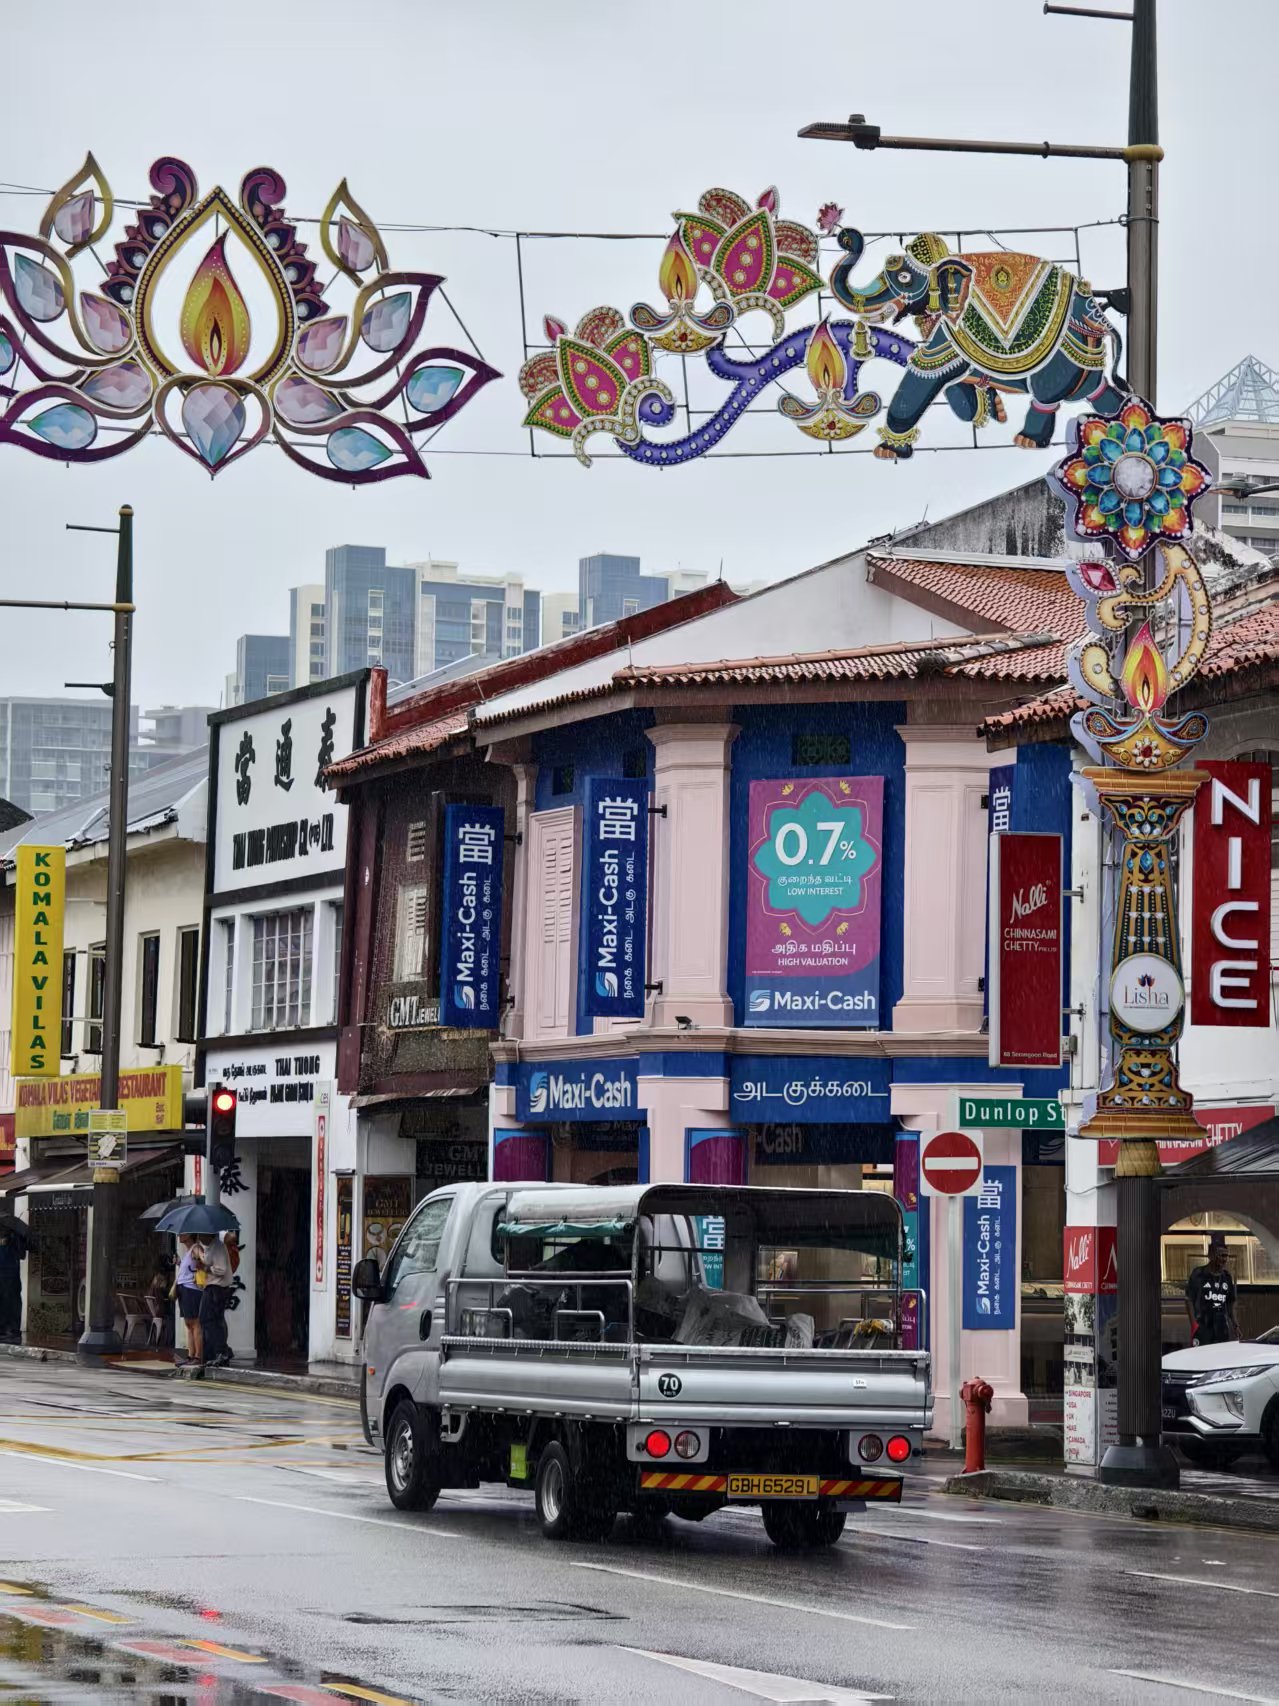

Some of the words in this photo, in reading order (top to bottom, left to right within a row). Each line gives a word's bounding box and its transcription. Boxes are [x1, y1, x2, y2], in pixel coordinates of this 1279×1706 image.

[598, 796, 639, 841] 當
[458, 823, 496, 866] 當
[775, 821, 857, 866] 0.7%
[597, 849, 619, 967] Maxi-Cash
[787, 887, 806, 896] LOW
[807, 887, 844, 895] INTEREST
[1009, 883, 1047, 924] Nalli
[1210, 777, 1261, 1010] NICE
[31, 852, 51, 965] KOMALA
[456, 872, 477, 982] Maxi-Cash
[1003, 927, 1057, 940] CHINNASAMI
[771, 940, 808, 955] அதிக
[778, 958, 799, 966] HIGH
[801, 958, 849, 966] VALUATION
[1003, 940, 1040, 952] CHETTY
[390, 995, 419, 1028] GMT
[774, 990, 876, 1010] Maxi-Cash
[1124, 985, 1169, 1005] Lisha
[29, 975, 49, 1069] VILAS
[549, 1071, 632, 1110] Maxi-Cash
[965, 1101, 1039, 1125] Dunlop
[976, 1214, 991, 1295] Maxi-Cash
[1066, 1232, 1090, 1279] Nalli
[1204, 1290, 1227, 1302] Jeep
[661, 1377, 679, 1391] 70
[1068, 1391, 1092, 1399] SINGAPORE
[1068, 1436, 1086, 1444] CANADA
